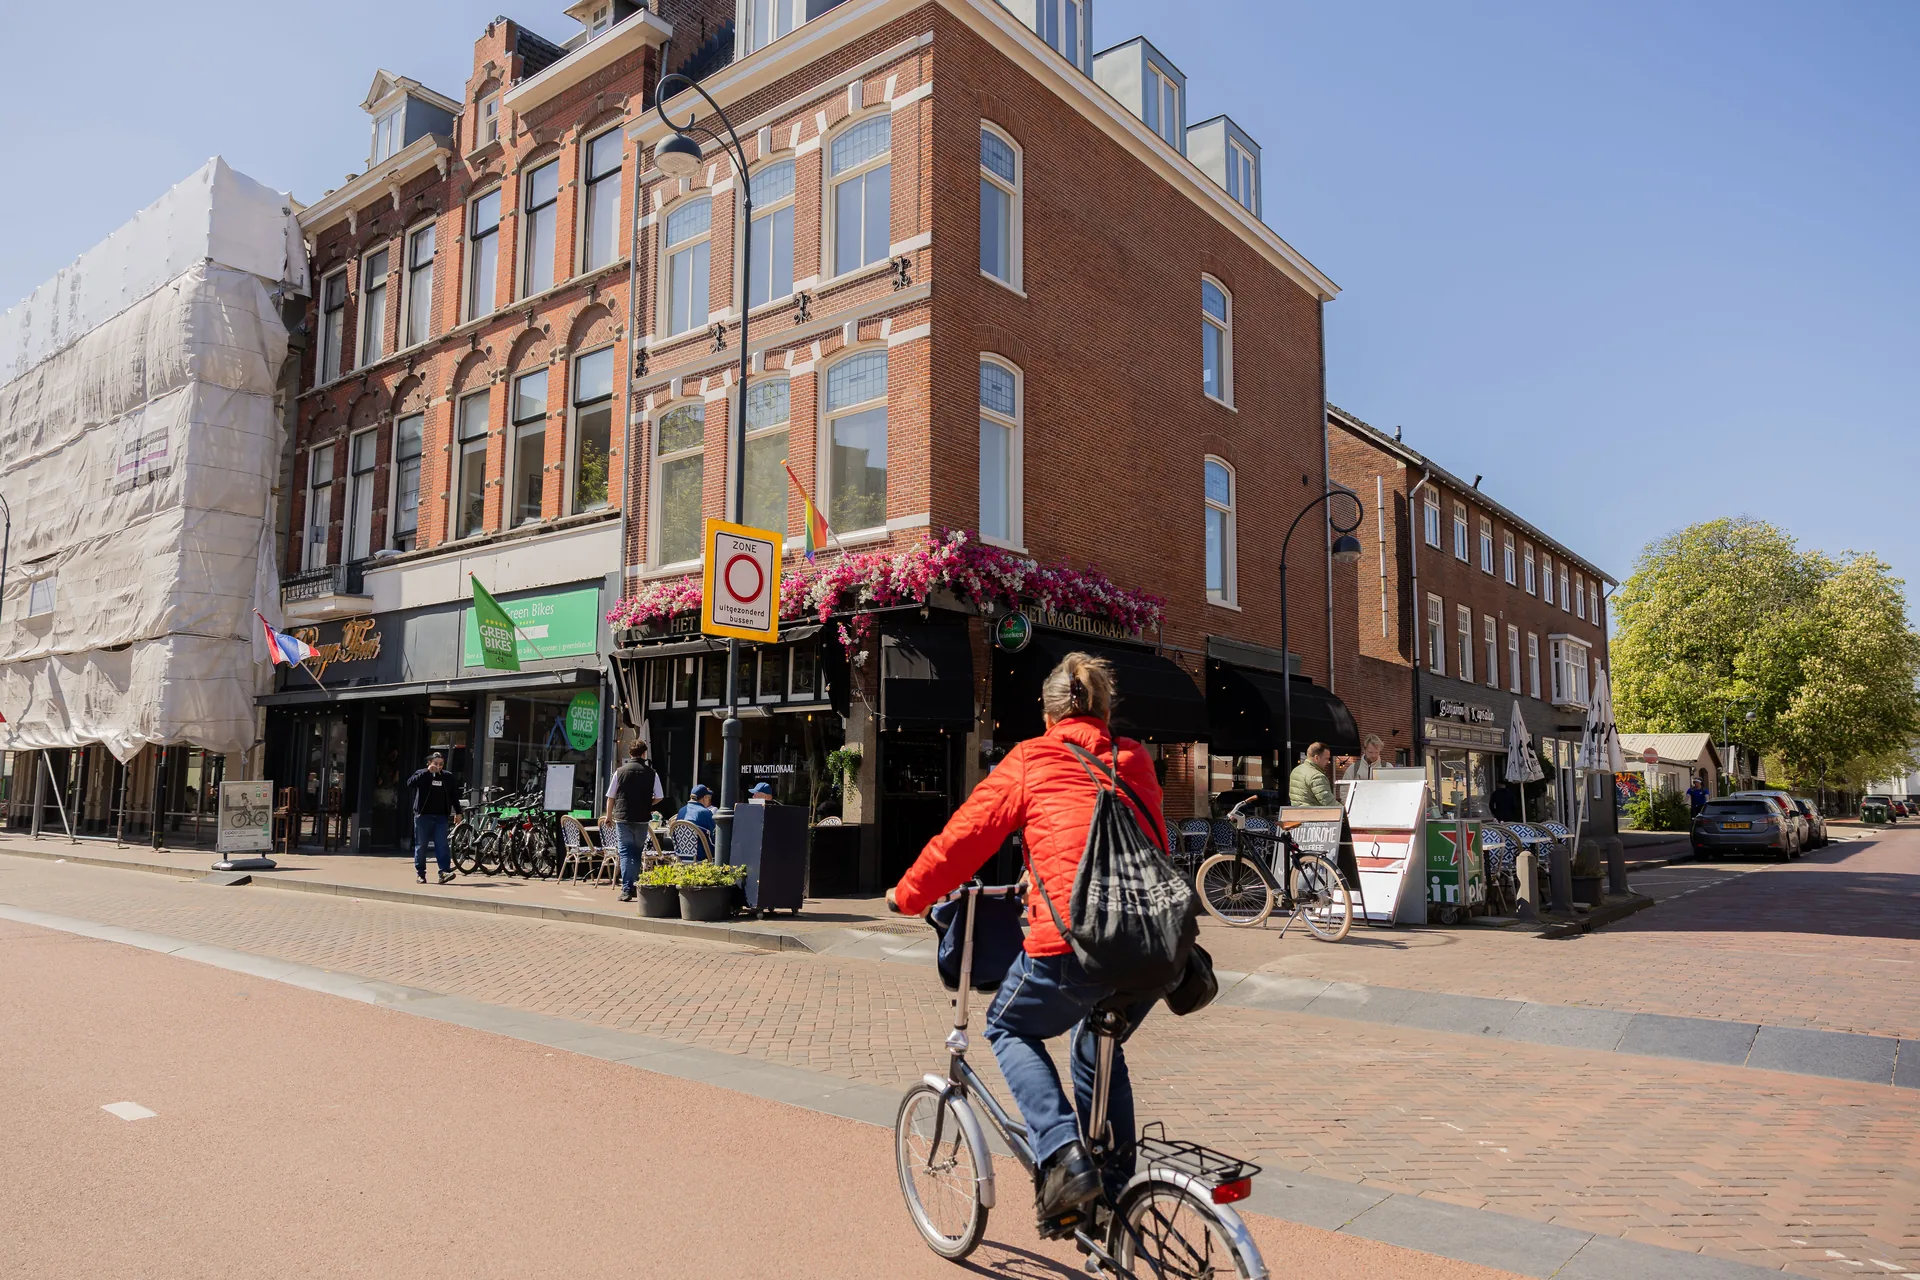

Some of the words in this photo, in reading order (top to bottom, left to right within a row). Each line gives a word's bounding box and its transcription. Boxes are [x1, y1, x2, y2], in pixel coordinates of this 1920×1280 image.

[733, 541, 757, 553] ZONE
[532, 602, 555, 617] Bikes
[719, 604, 765, 617] uitgezonderd
[1018, 603, 1043, 623] HET
[670, 617, 696, 633] HET
[729, 615, 754, 625] bussen
[480, 625, 513, 641] GREEN
[485, 636, 512, 652] BIKES
[571, 706, 598, 720] GREEN
[572, 719, 594, 733] BIKES
[741, 765, 752, 774] HET
[753, 764, 795, 774] WACHTLOKAAL
